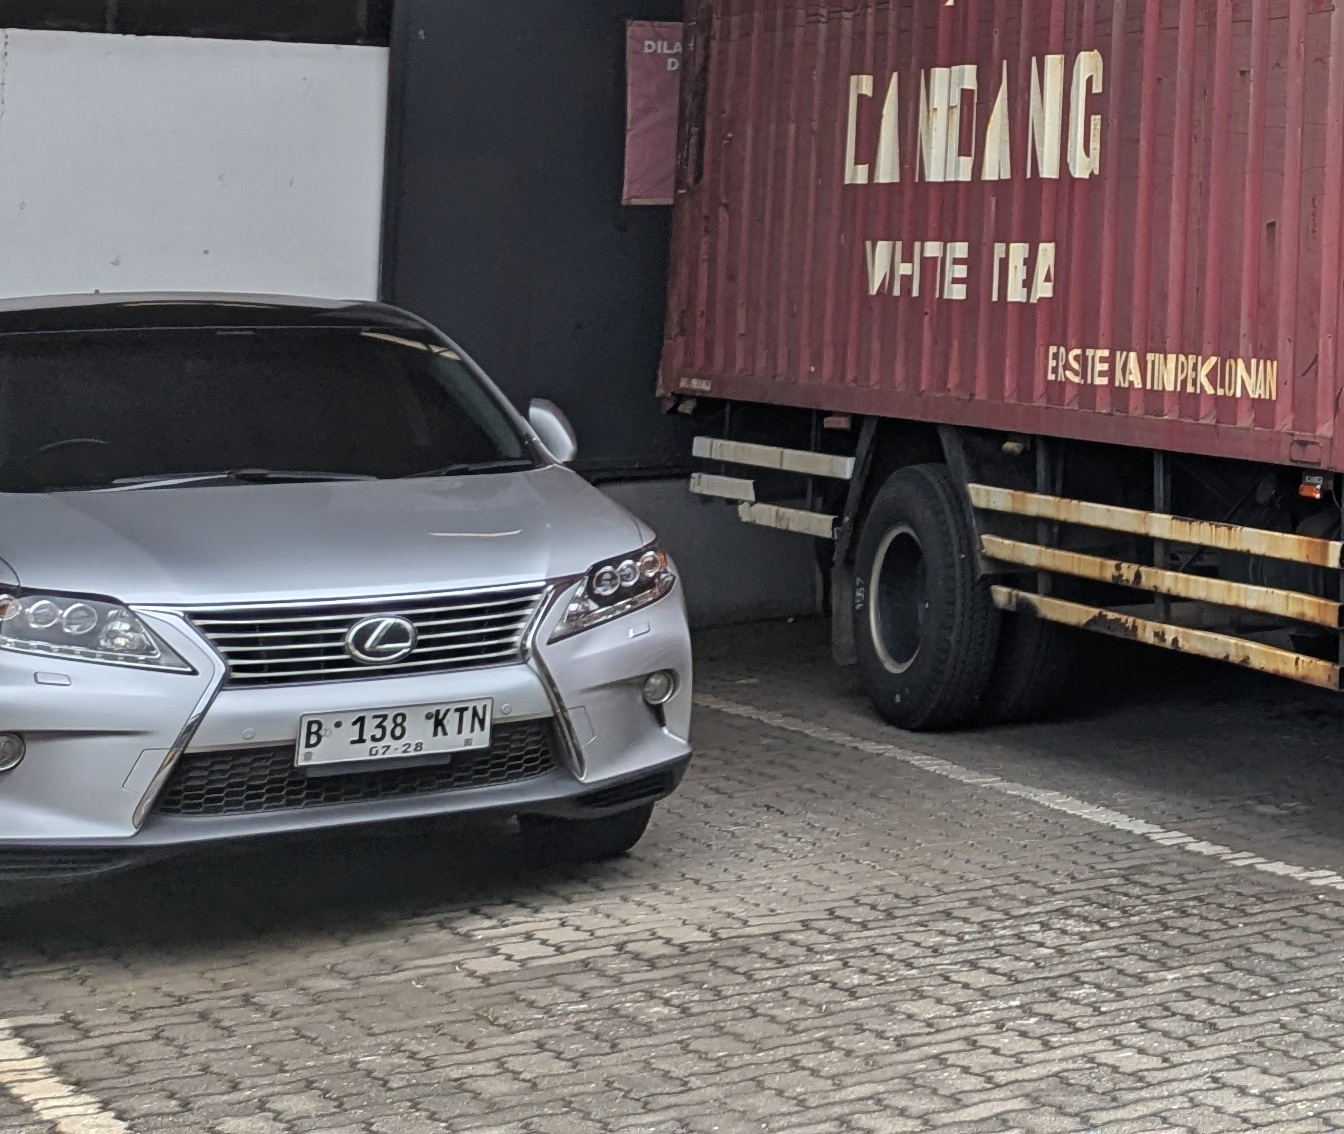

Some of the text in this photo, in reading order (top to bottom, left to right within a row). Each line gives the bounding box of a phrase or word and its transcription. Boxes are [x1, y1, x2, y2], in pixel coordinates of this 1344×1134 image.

[991, 242, 1056, 304] TEA
[304, 704, 488, 749] B 138 KTN
